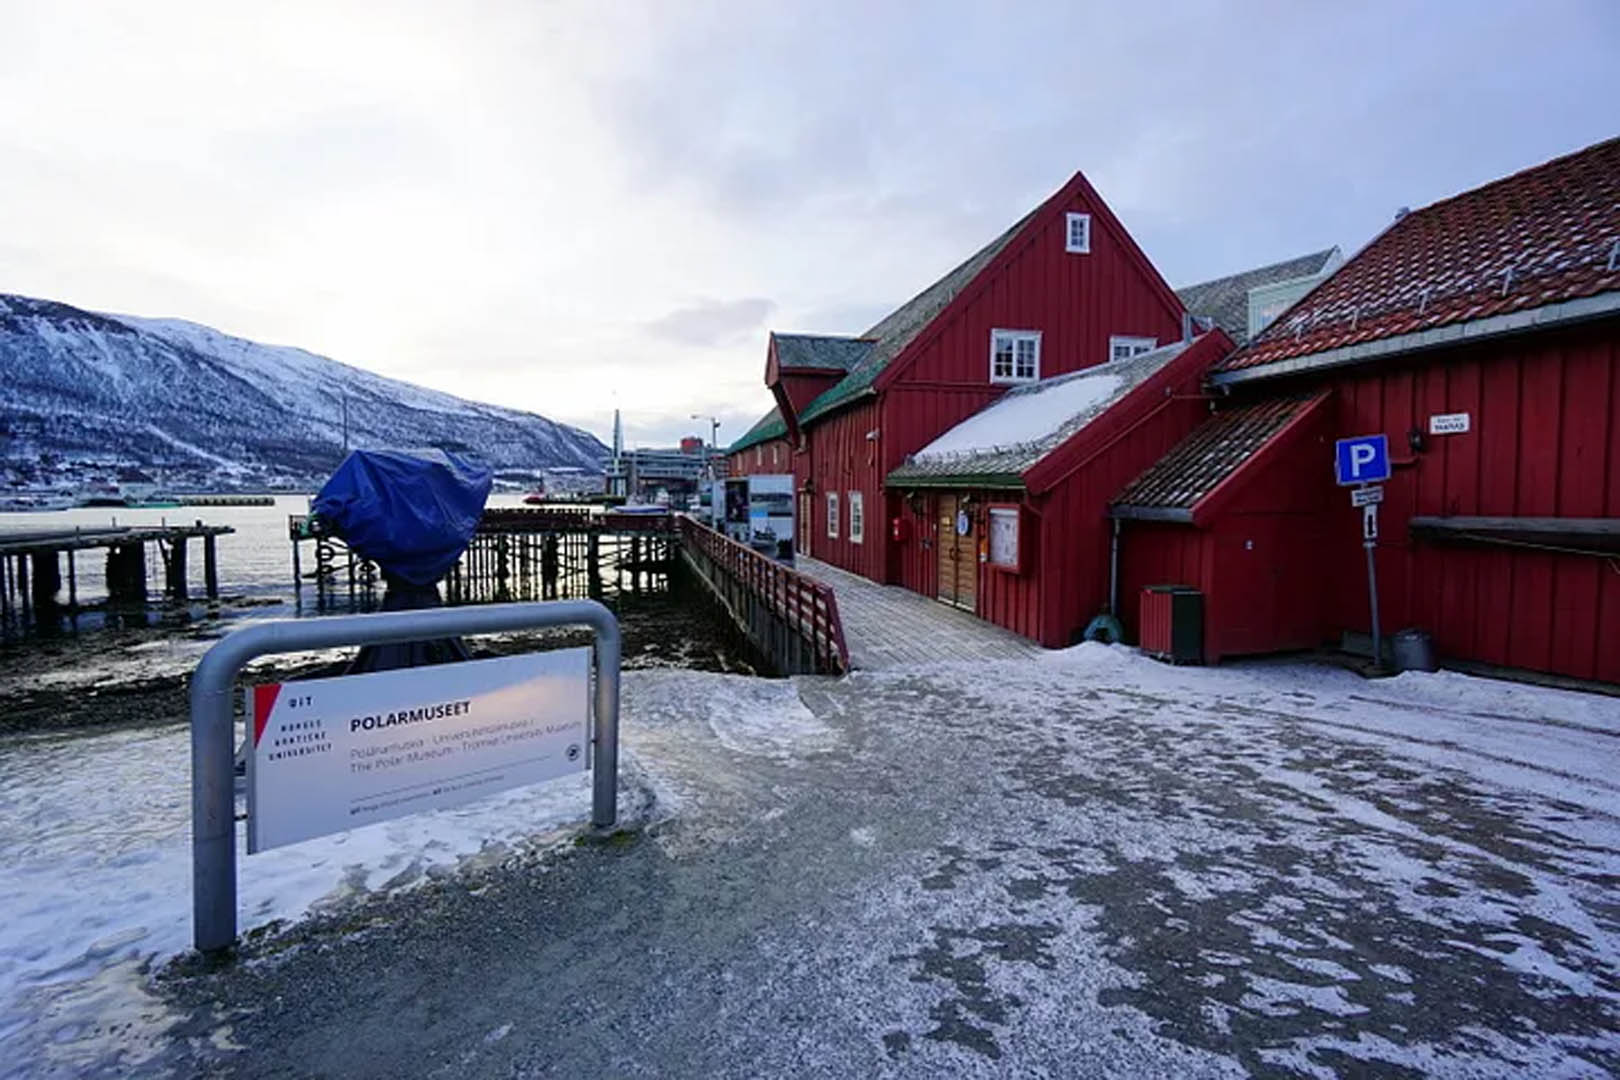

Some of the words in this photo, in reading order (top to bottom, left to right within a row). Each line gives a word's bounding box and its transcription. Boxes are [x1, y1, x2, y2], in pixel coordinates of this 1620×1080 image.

[1350, 443, 1377, 477] P
[350, 700, 470, 732] POLARMUSEET
[350, 762, 372, 774] The
[375, 755, 404, 769] Polar
[407, 746, 452, 762] Museum
